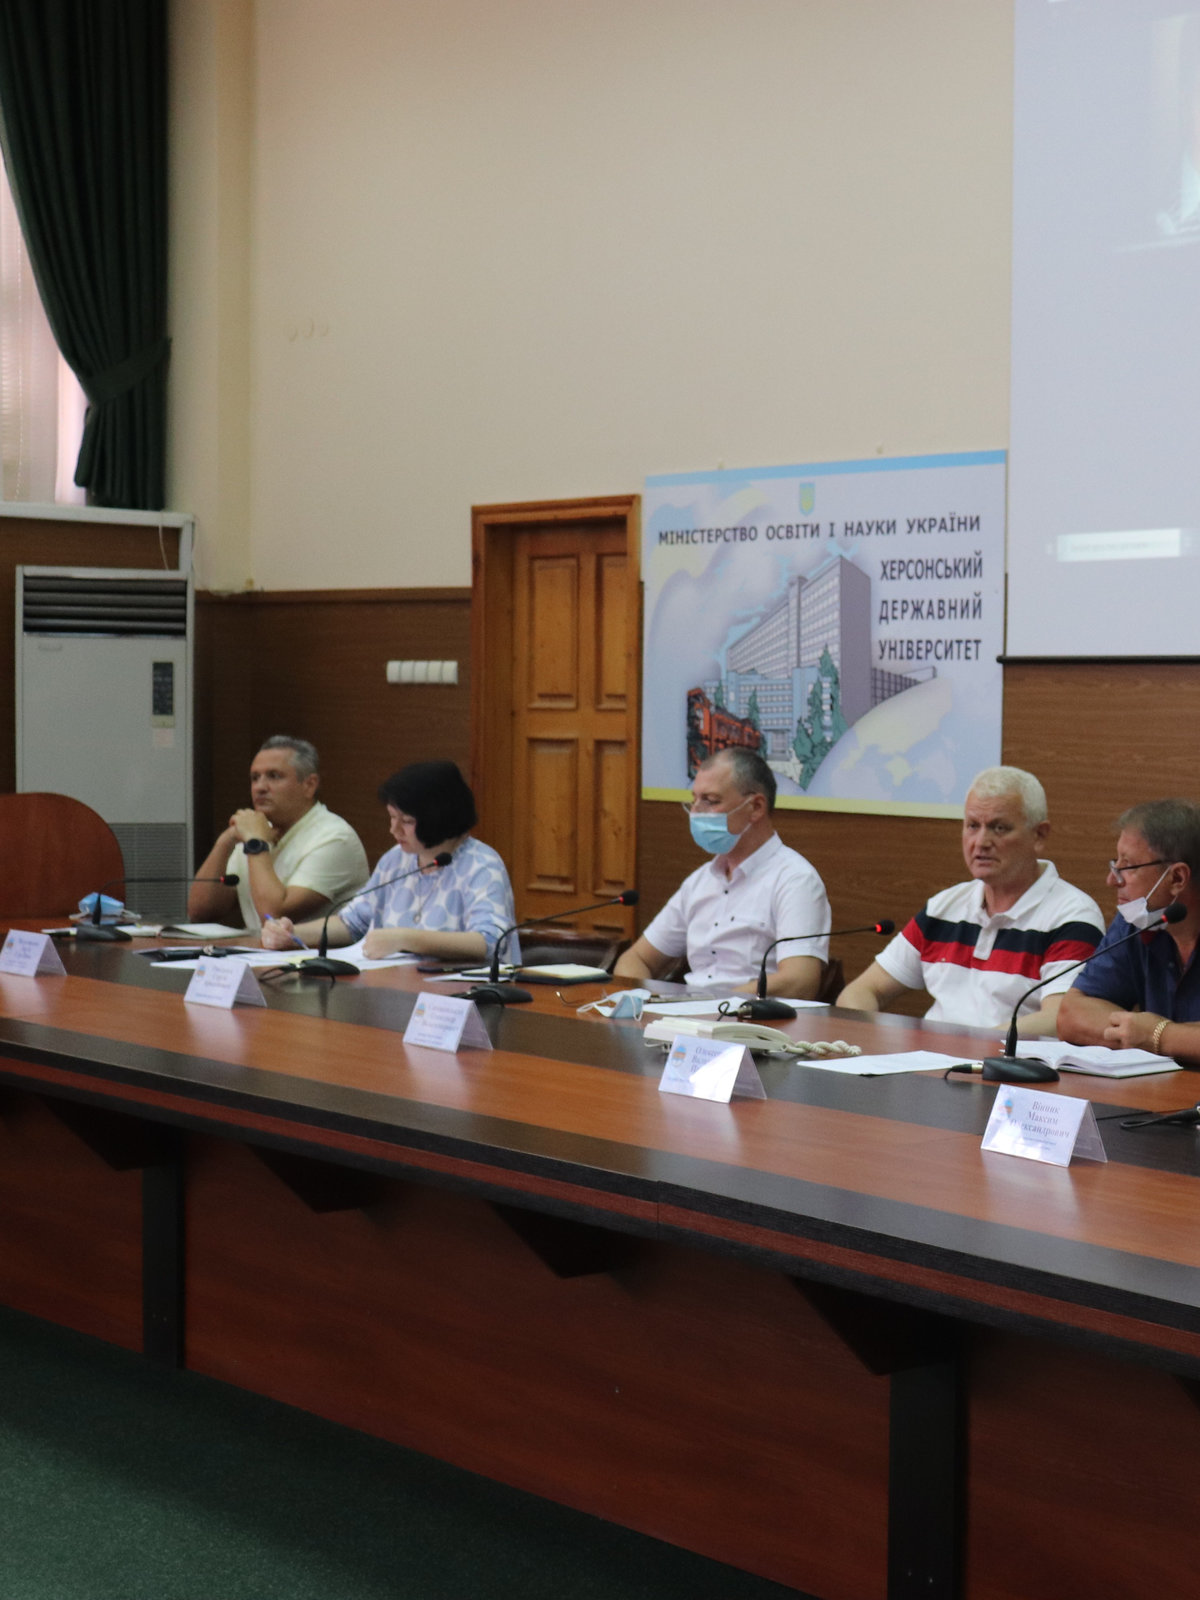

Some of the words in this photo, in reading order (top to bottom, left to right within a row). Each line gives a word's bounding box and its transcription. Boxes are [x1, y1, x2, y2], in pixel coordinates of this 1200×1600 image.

[658, 526, 758, 546] МІНІСТЕРСТВО
[766, 522, 820, 541] ОСВІТИ
[829, 520, 835, 538] І
[844, 518, 897, 537] НАУКИ
[906, 512, 980, 535] УКРАЇНИ
[880, 551, 983, 580] ХЕРСОНСЬКИЙ
[879, 592, 983, 624] ДЕРЖАВНИЙ
[879, 639, 982, 661] УНІВЕРСИТЕТ
